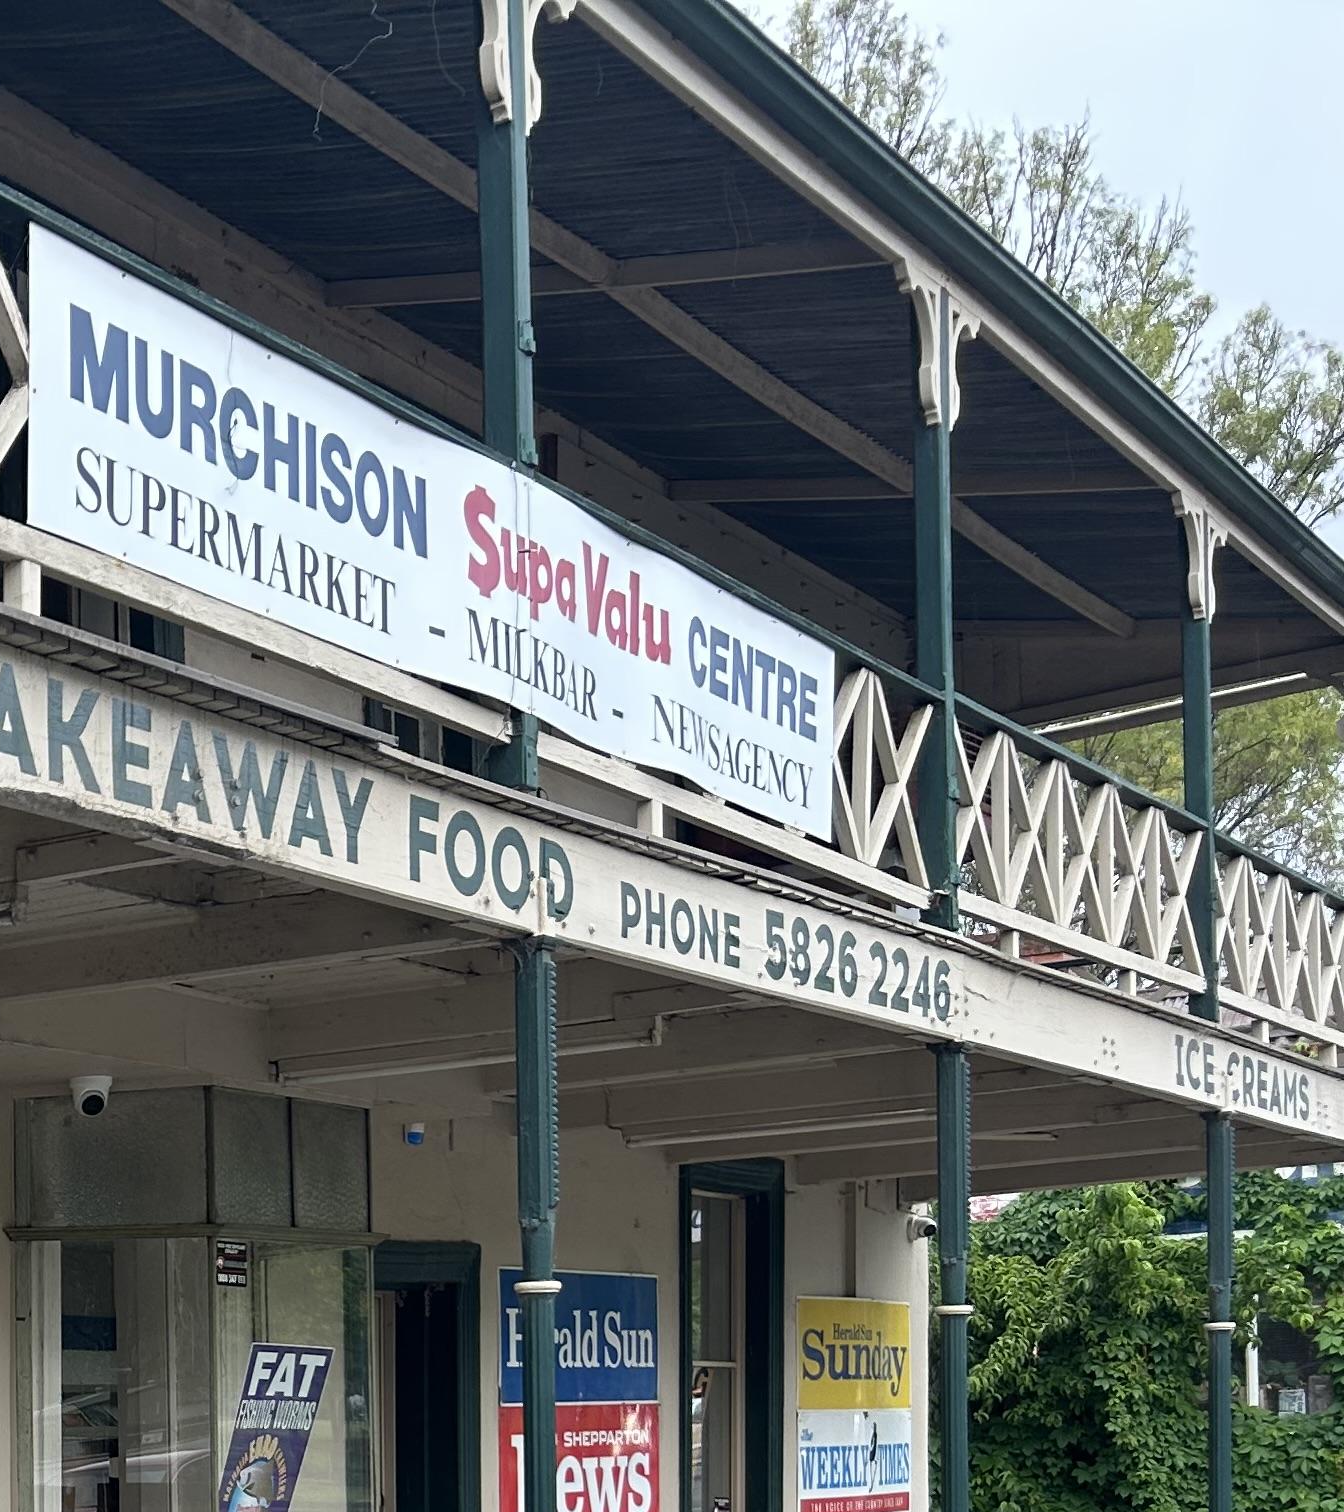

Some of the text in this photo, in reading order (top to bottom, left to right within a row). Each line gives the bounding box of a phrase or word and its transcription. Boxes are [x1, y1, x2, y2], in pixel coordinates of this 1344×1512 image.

[69, 302, 428, 559] MURCHISON
[688, 615, 819, 743] CENTRE
[75, 446, 396, 635] SUPERMARKET
[467, 608, 598, 722] MILKBAR
[651, 694, 815, 810] NEWSAGENCY
[409, 793, 575, 923] FOOD
[620, 880, 952, 1022] PHONE 5826 2246
[1173, 1034, 1311, 1123] ICE CREAMS
[247, 1351, 327, 1398] FAT
[604, 1311, 655, 1369] Sun
[802, 1328, 907, 1397] Sunday
[235, 1400, 318, 1432] FISHING WORMS
[563, 1428, 650, 1448] SHEPPARTON
[800, 1442, 910, 1491] WEEKLY TIMES
